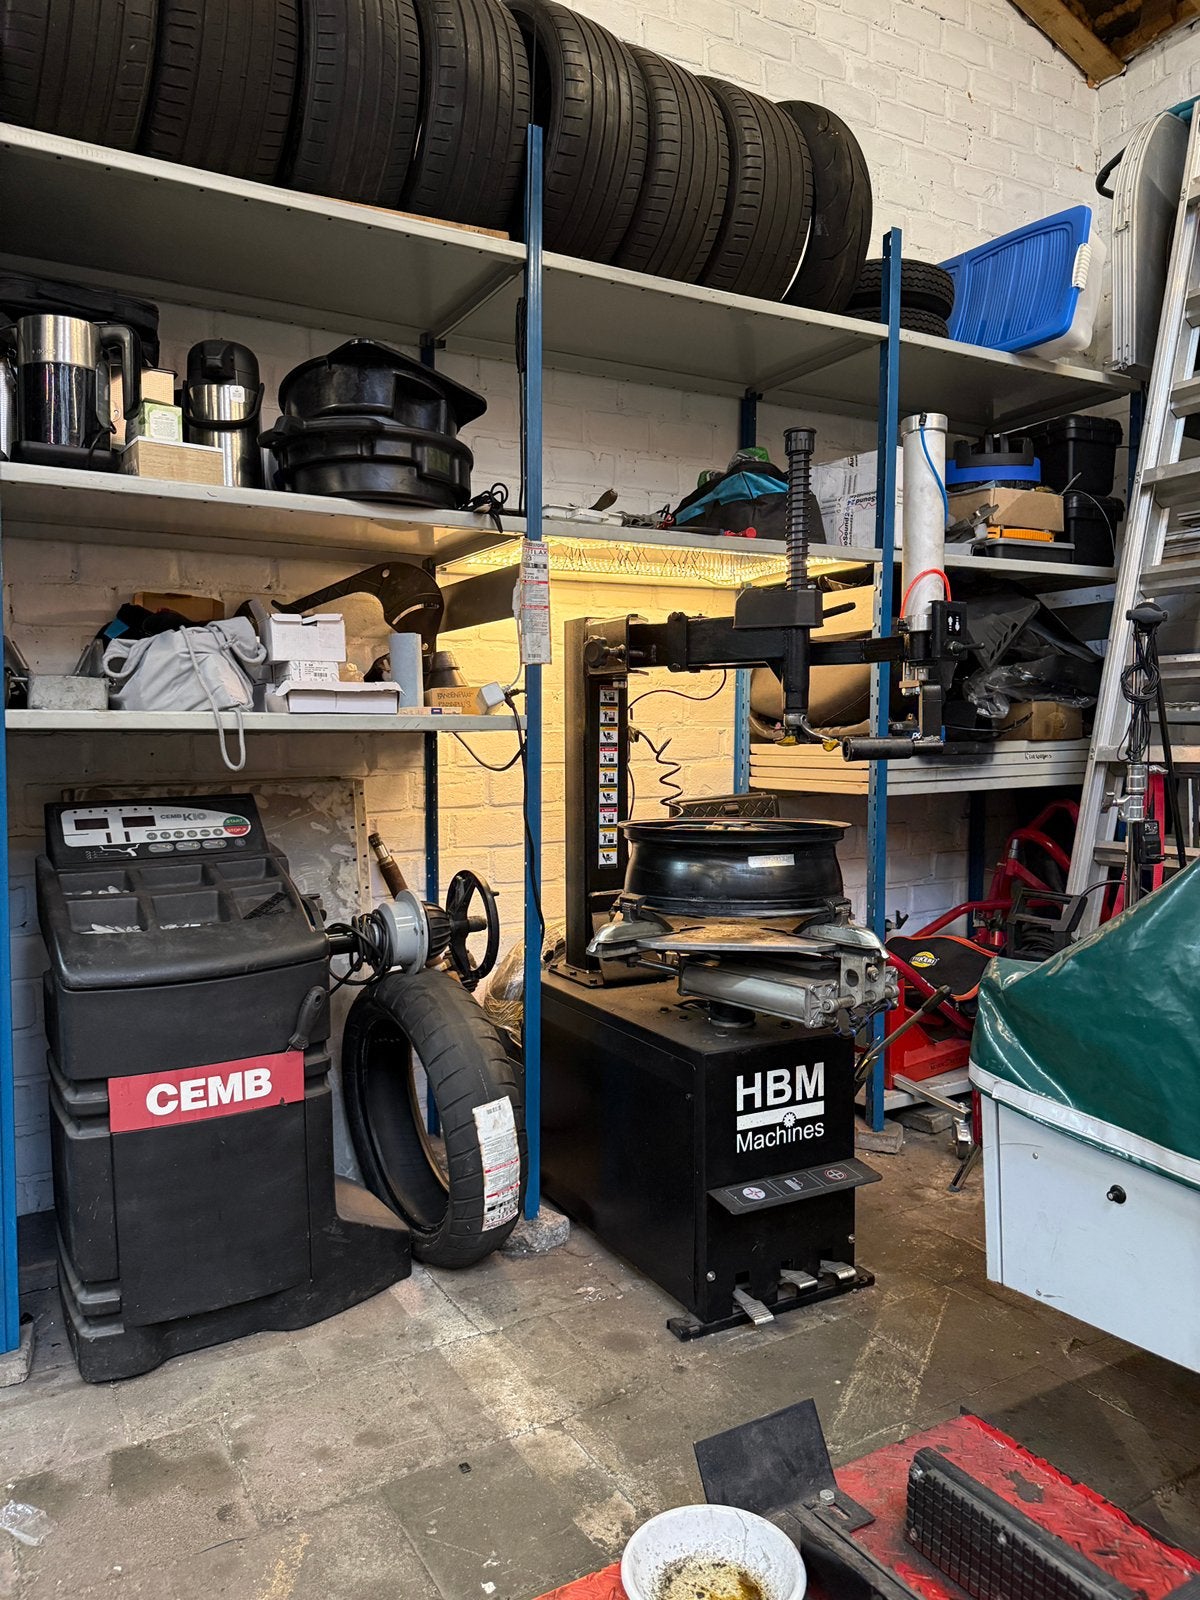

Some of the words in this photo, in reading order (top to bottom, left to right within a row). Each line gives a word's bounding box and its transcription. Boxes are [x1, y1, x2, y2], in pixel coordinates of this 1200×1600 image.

[160, 813, 182, 821] CEMB
[146, 1067, 272, 1116] CEMB
[736, 1062, 825, 1112] HBM
[736, 1122, 825, 1154] Machines
